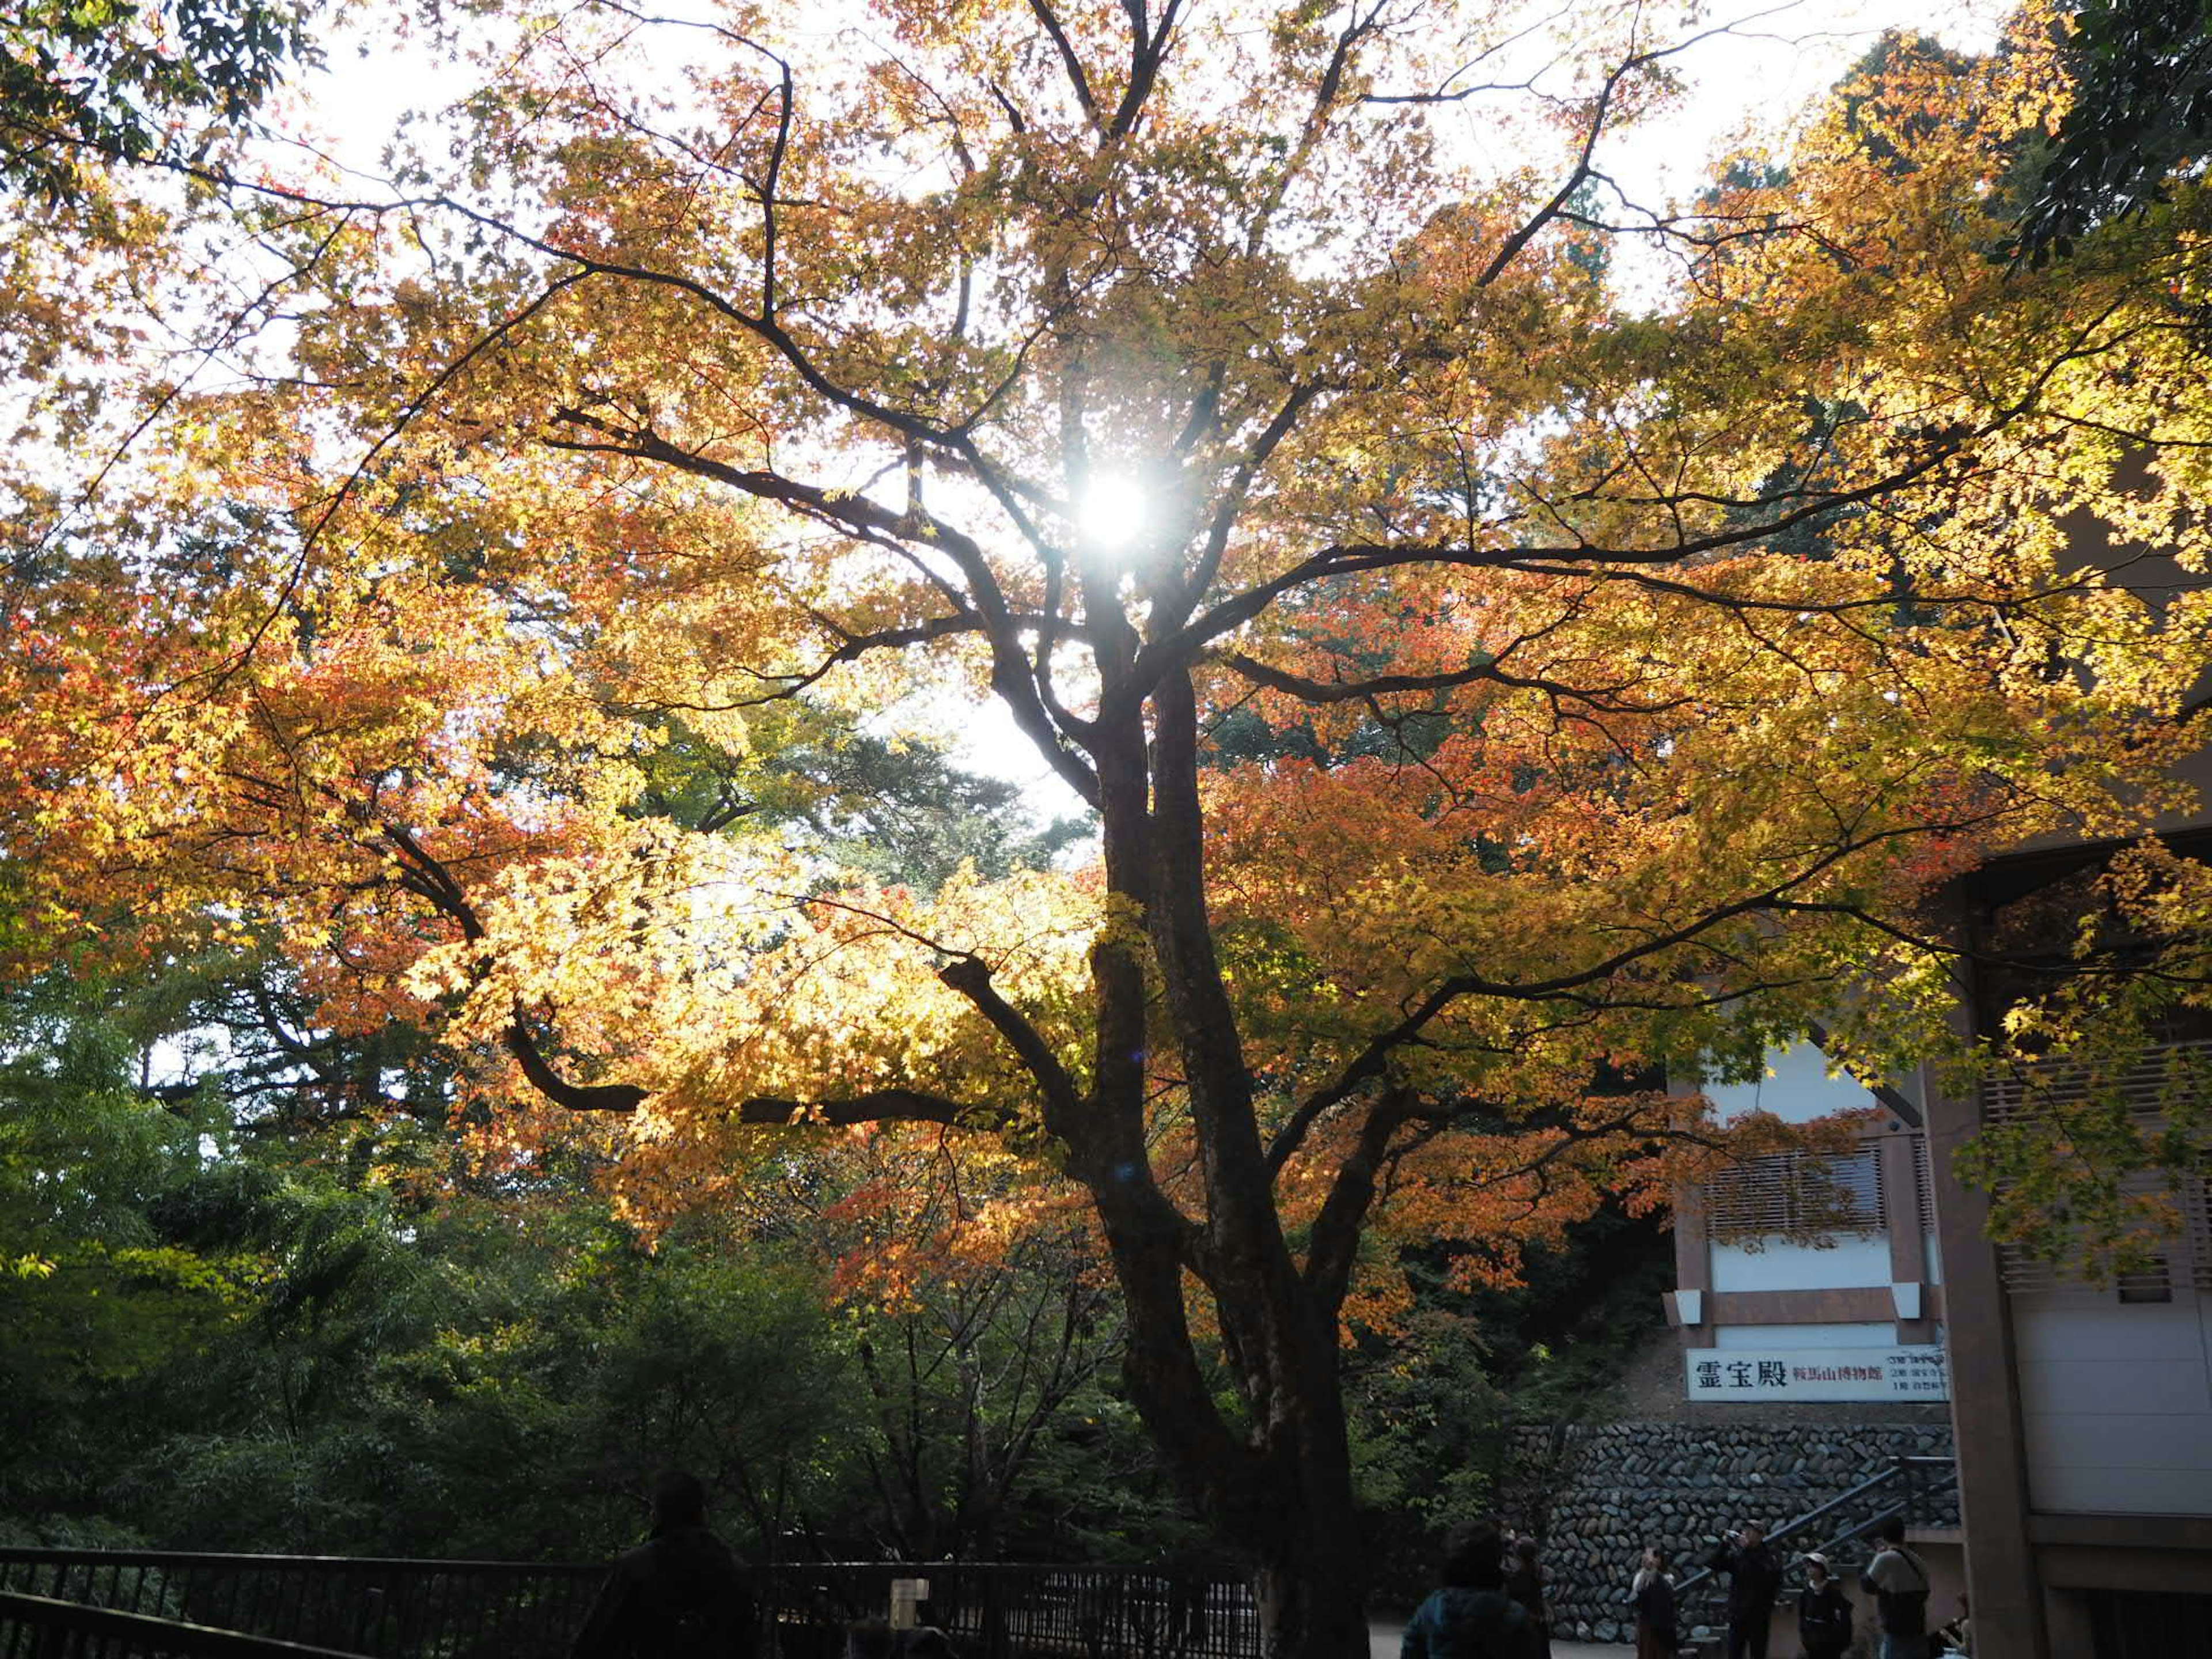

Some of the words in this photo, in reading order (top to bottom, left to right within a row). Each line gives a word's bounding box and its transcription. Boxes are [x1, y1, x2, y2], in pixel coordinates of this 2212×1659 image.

[1696, 1360, 1788, 1387] 霊宝殿
[1793, 1366, 1884, 1381] 鞍馬山博物館
